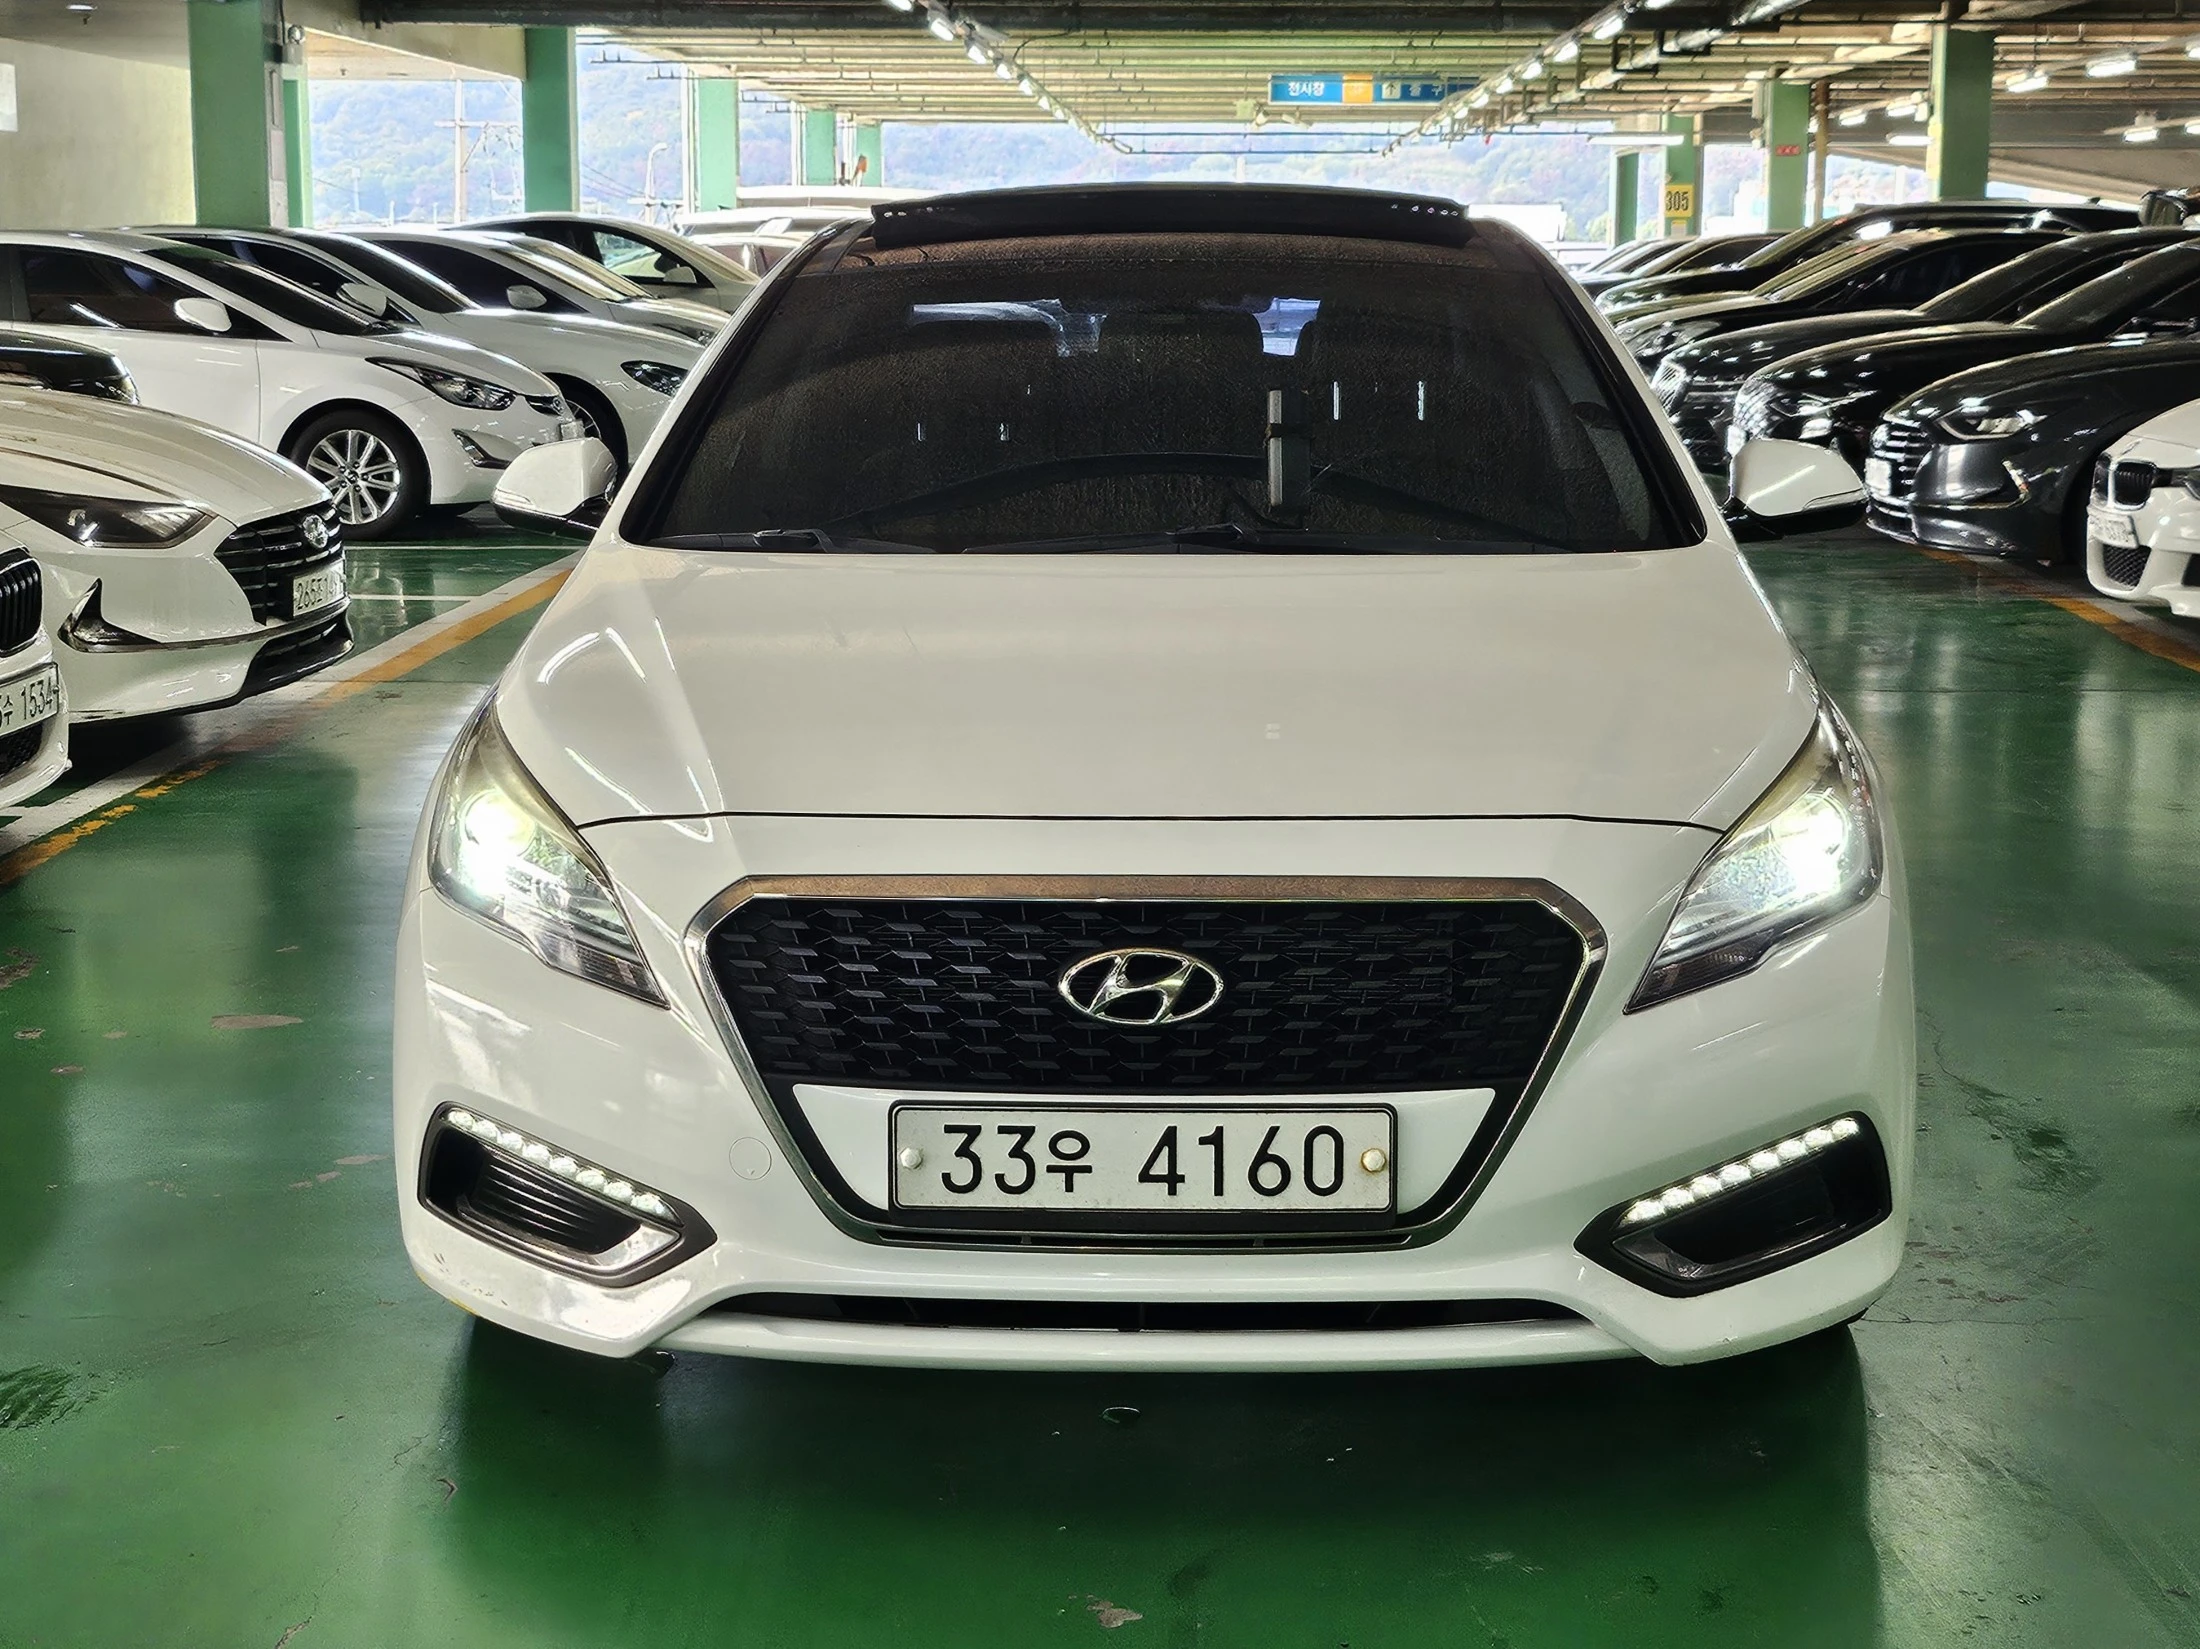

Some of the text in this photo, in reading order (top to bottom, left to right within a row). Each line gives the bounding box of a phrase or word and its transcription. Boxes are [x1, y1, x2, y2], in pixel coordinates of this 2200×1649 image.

[1287, 81, 1325, 97] 전시장
[1665, 190, 1689, 212] 305
[21, 676, 53, 720] 1534
[941, 1124, 1345, 1198] 33우 4160
